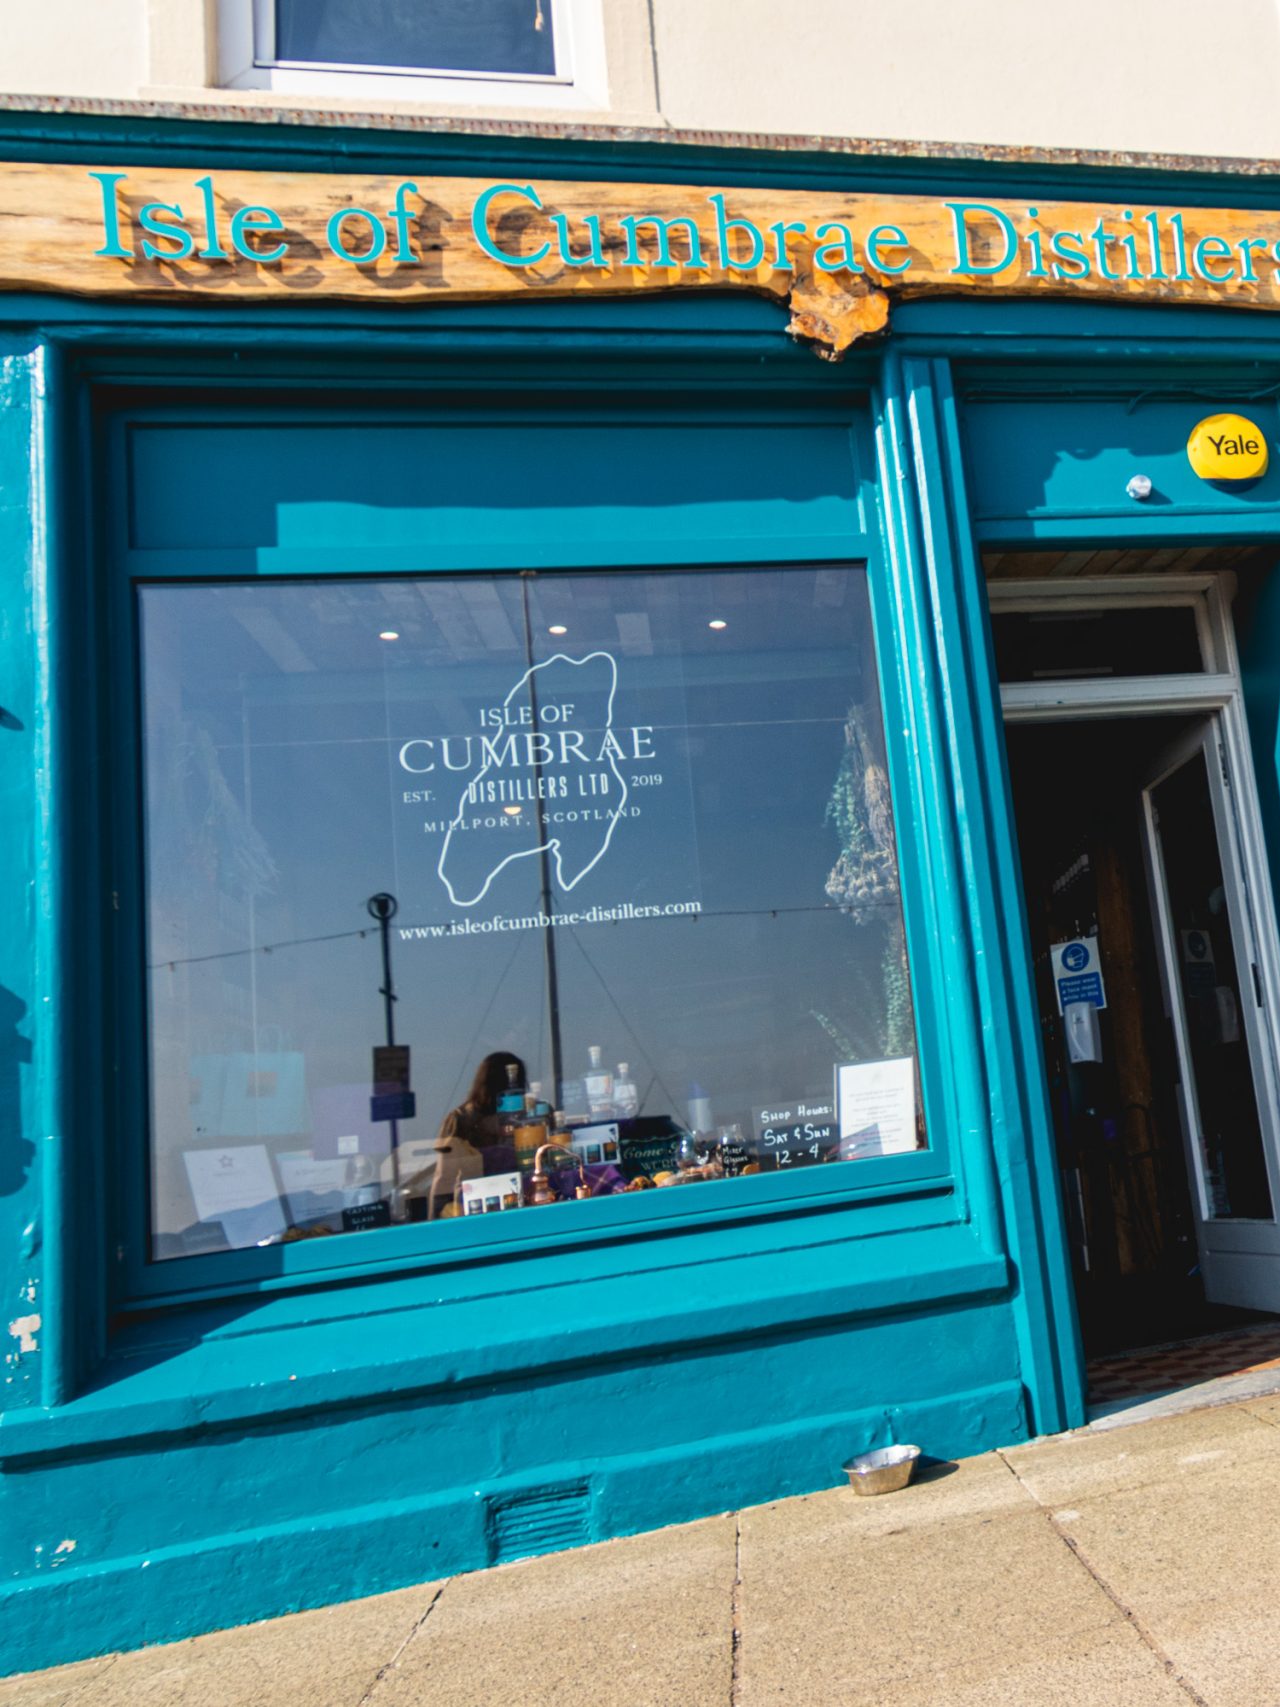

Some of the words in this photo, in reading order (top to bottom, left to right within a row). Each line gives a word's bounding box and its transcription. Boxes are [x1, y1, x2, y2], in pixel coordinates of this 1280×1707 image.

[88, 172, 289, 262] Isle
[326, 182, 420, 264] of
[470, 184, 914, 275] Cumbrae
[1207, 434, 1260, 456] Yale
[479, 706, 533, 727] ISLE
[540, 704, 575, 724] OF
[399, 725, 656, 773] CUMBRAE
[468, 775, 568, 804] DISTILLERS
[579, 773, 609, 796] LTD
[631, 773, 663, 787] 2019
[403, 790, 436, 803] EST.
[541, 806, 642, 824] SCOTLAND
[400, 900, 703, 940] www.isleofcumbrae-distillers.com
